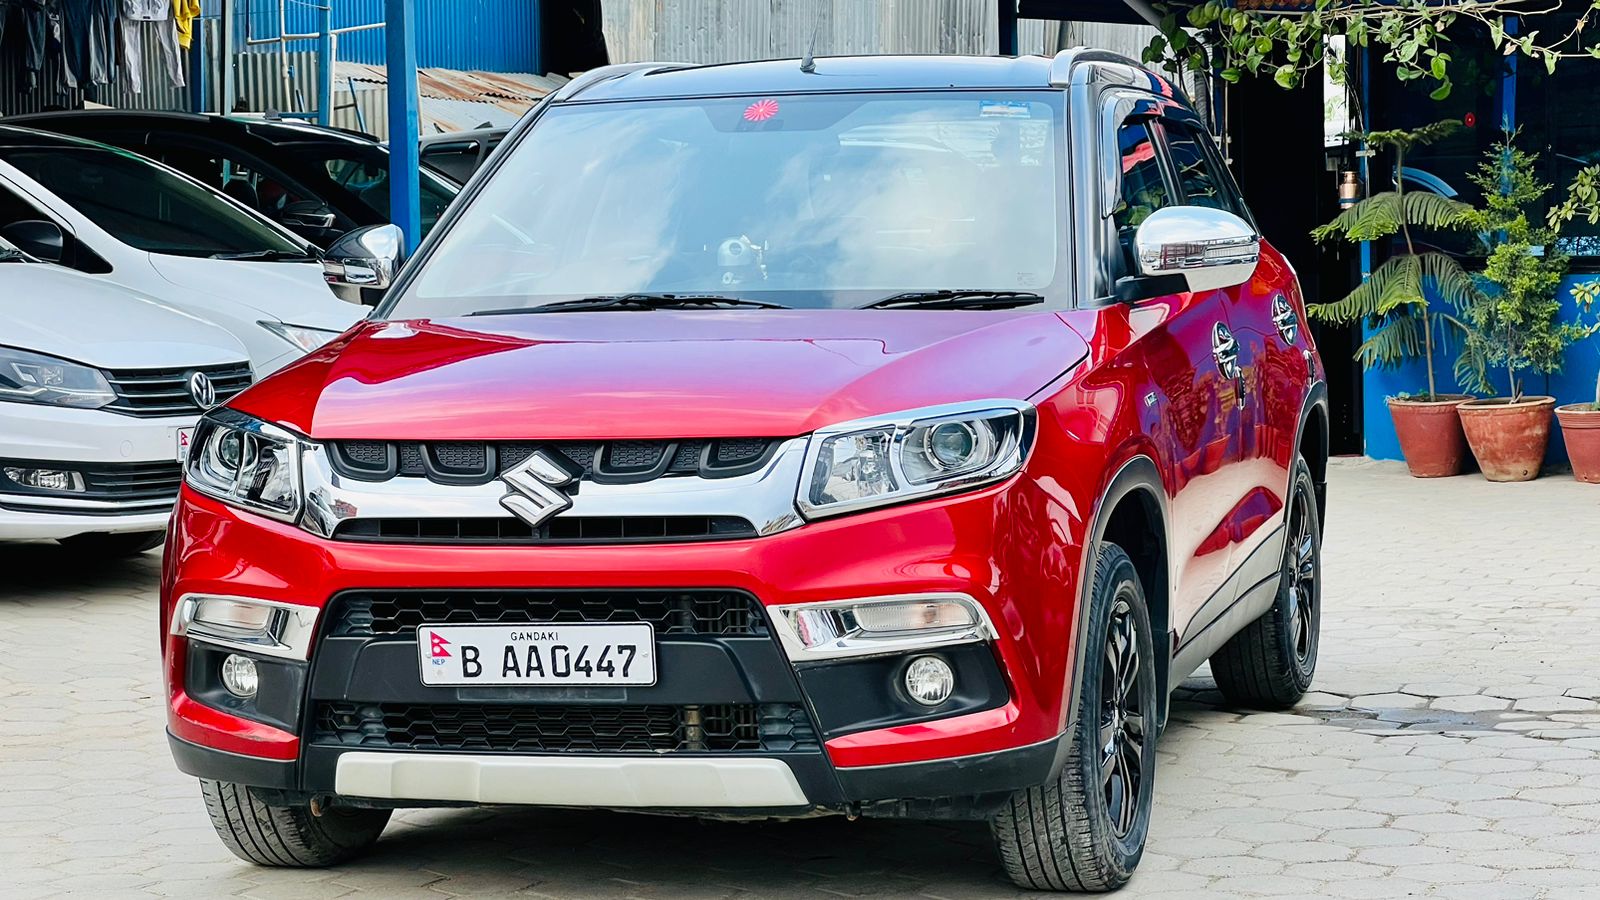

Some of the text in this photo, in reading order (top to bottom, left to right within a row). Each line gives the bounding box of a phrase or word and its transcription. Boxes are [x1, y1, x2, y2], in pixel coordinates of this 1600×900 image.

[510, 631, 559, 641] GANDAKI
[460, 644, 637, 678] B AA0447
